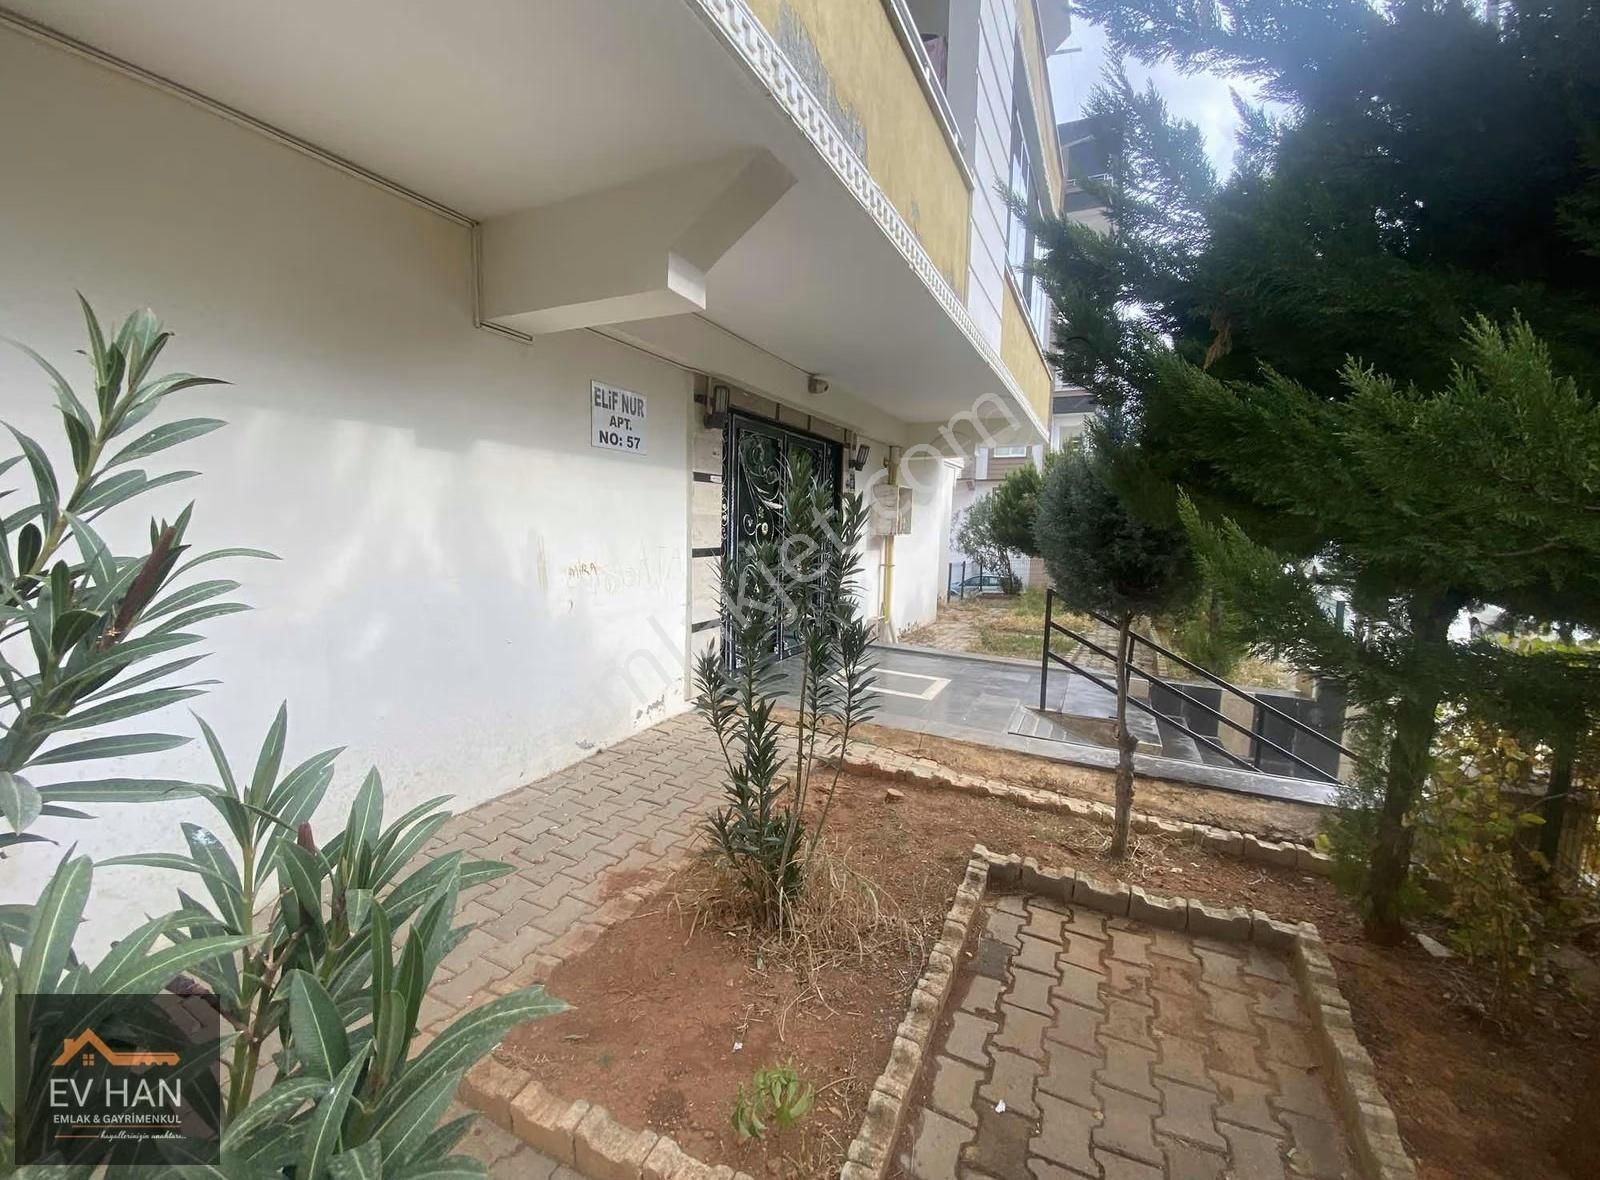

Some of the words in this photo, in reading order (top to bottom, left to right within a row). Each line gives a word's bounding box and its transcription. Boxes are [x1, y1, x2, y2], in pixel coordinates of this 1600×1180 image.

[621, 393, 645, 418] NUR
[609, 415, 632, 431] APT.
[599, 430, 622, 446] NO:
[627, 435, 641, 449] 57
